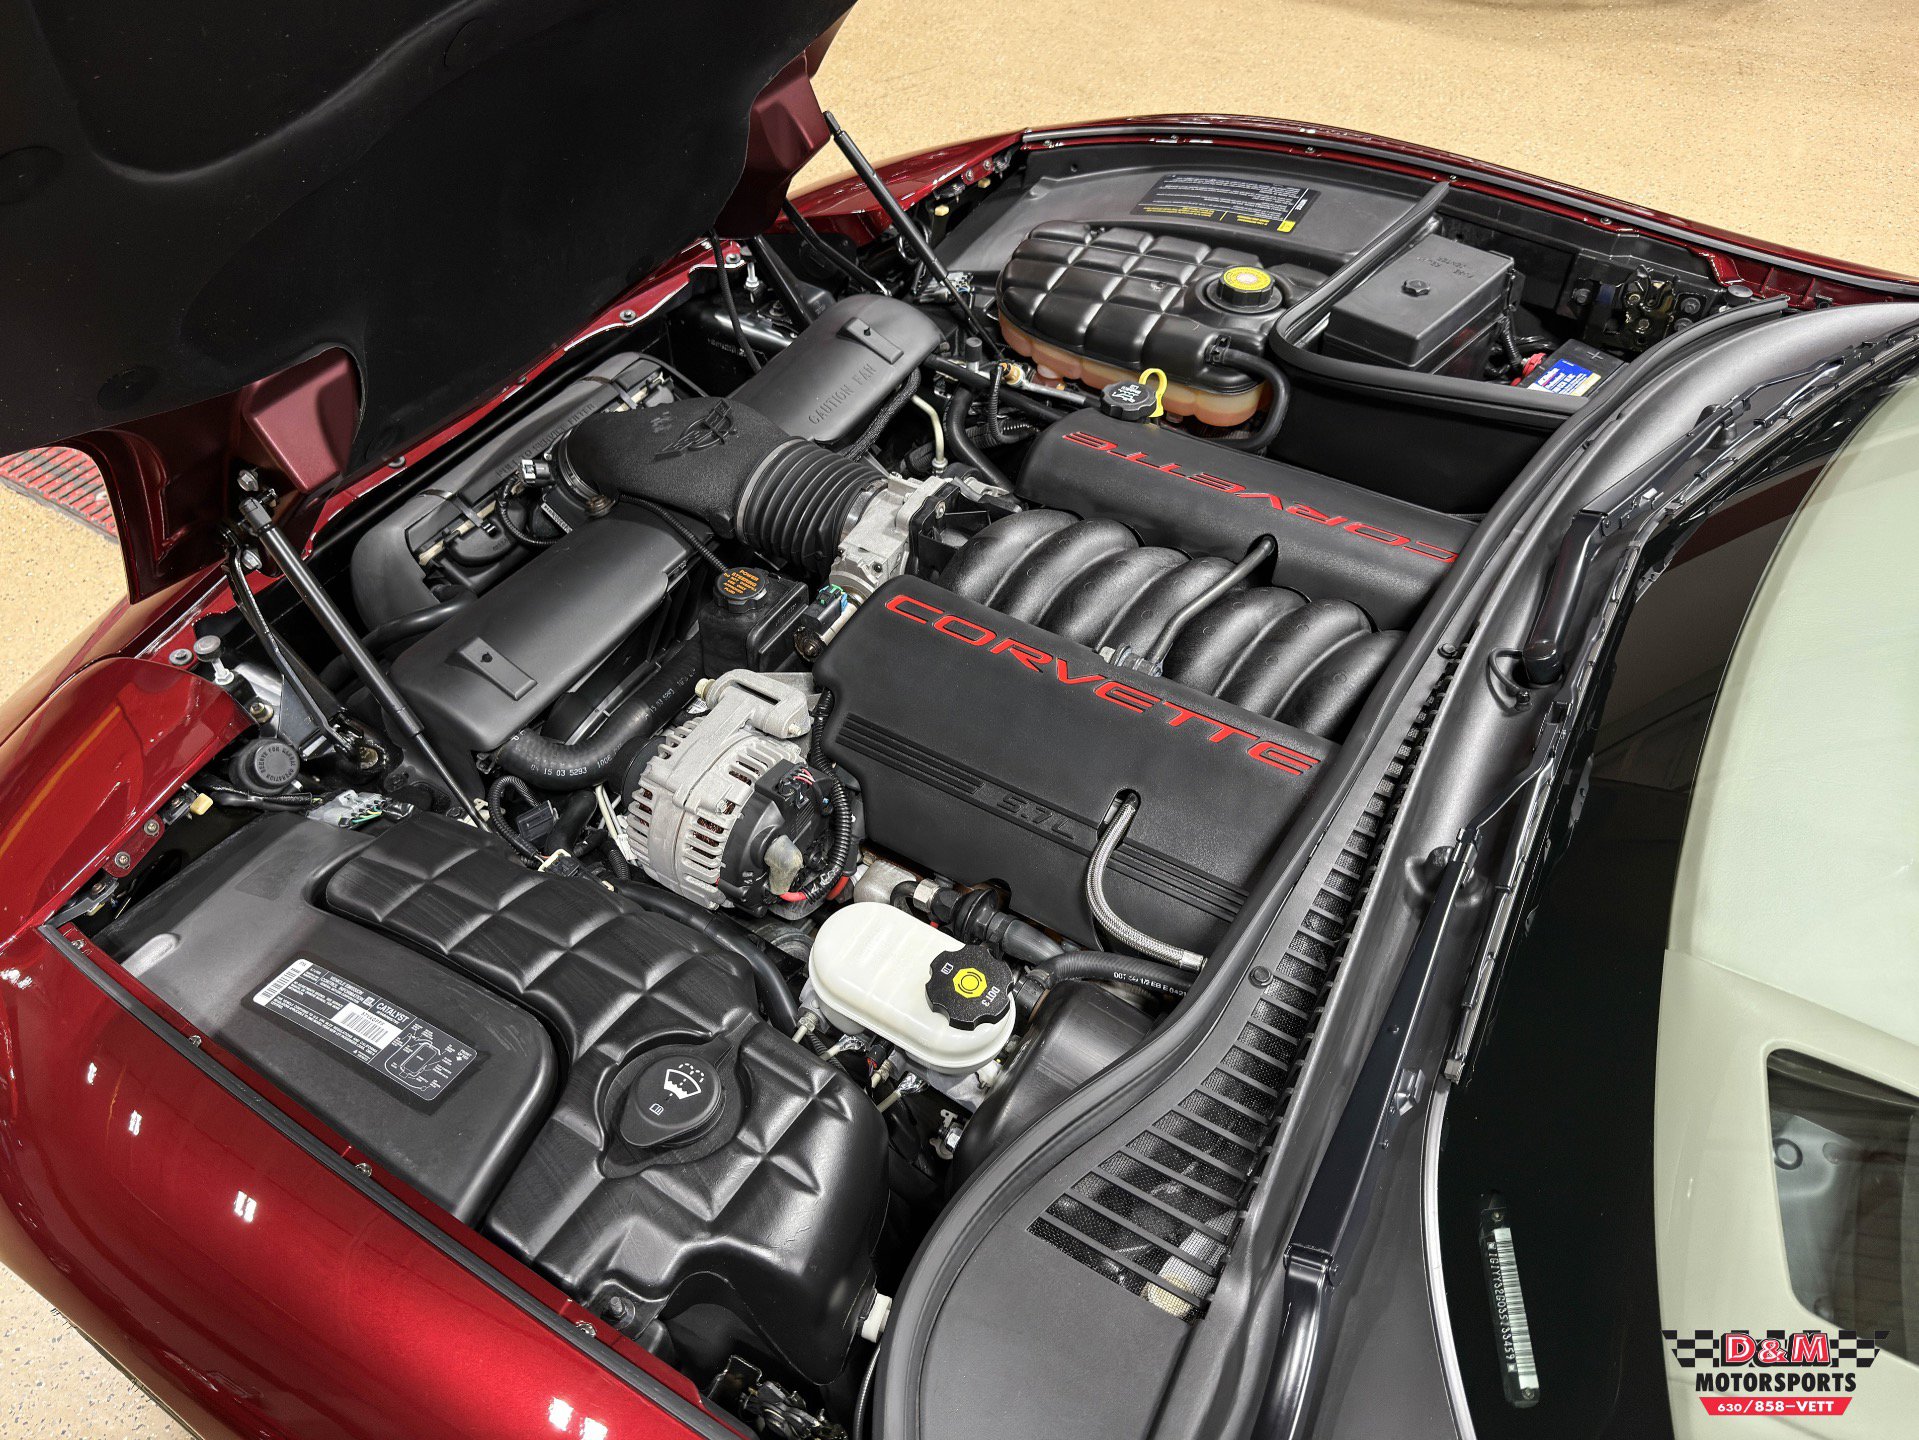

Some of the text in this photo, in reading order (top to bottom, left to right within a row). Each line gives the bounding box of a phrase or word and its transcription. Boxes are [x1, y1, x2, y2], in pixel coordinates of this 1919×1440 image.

[808, 363, 877, 425] CAUTION FAN
[567, 403, 595, 424] FILTER
[1062, 431, 1459, 563] CORVETTE
[731, 572, 757, 587] STEERING
[740, 569, 759, 581] POWER
[884, 594, 1321, 776] CORVETTE
[556, 769, 566, 777] 03
[569, 767, 588, 776] 5293
[996, 794, 1075, 840] 5.7L
[985, 986, 1001, 1003] DOT
[376, 1002, 410, 1023] CATALYST
